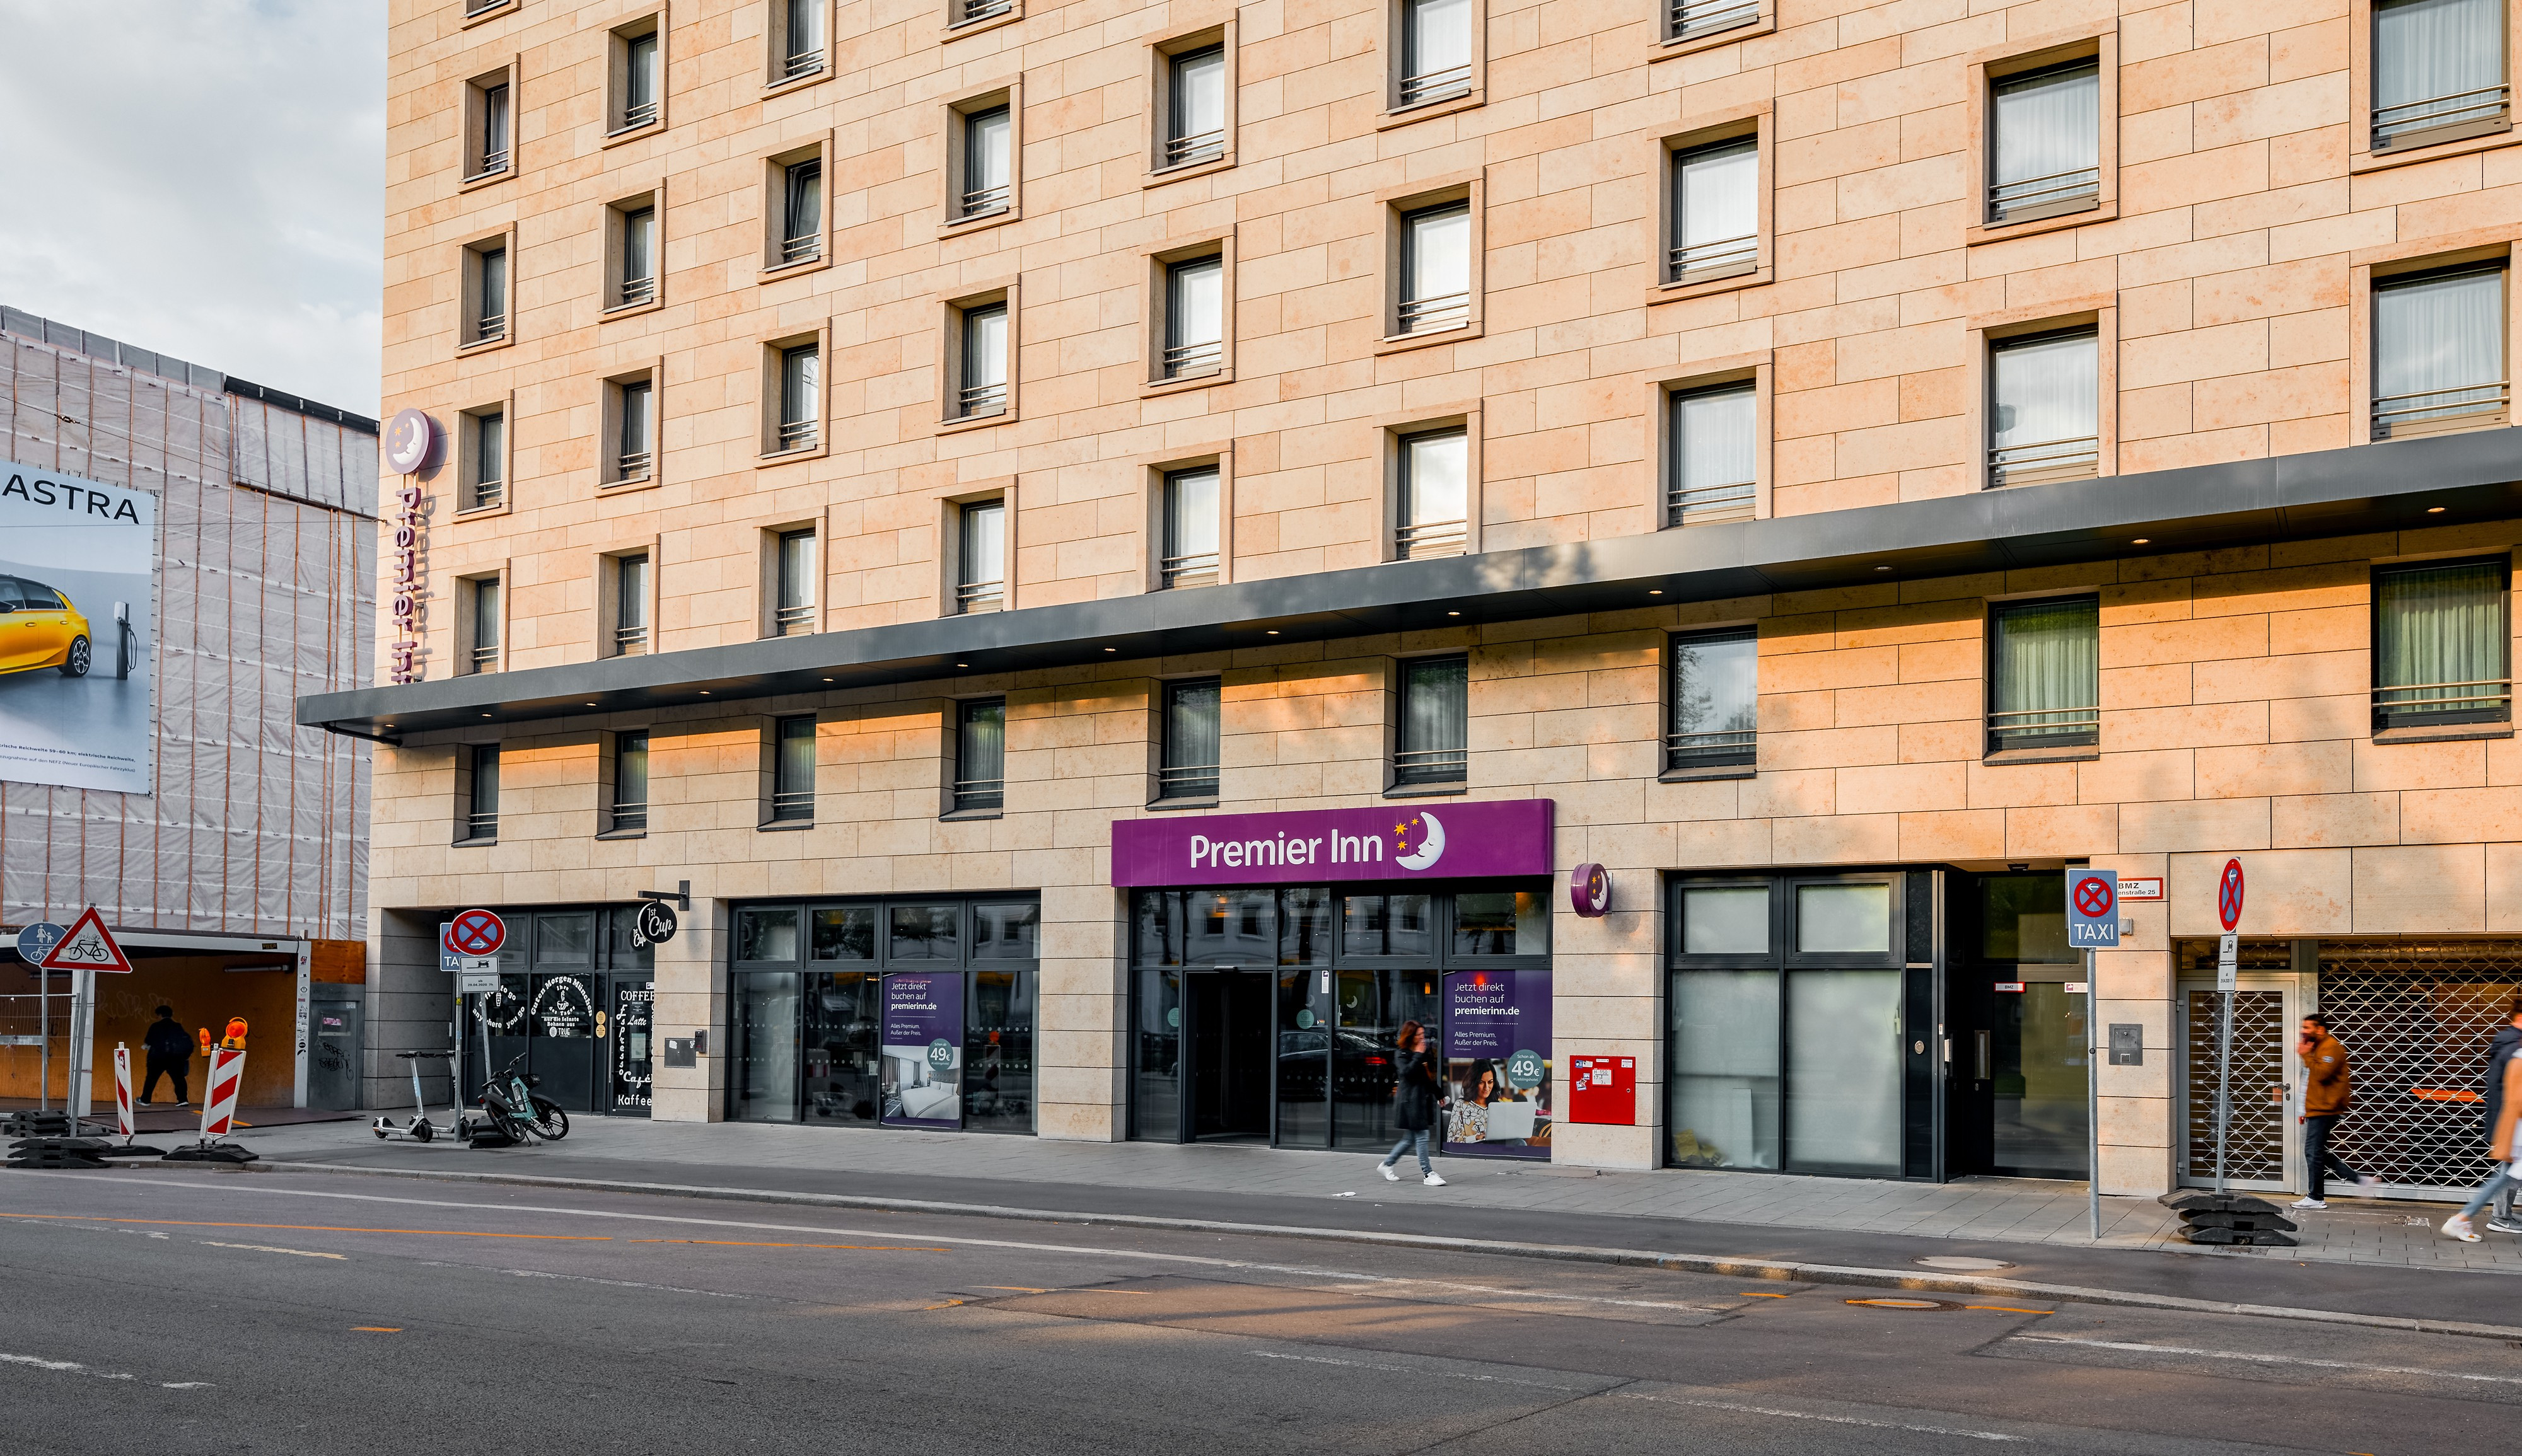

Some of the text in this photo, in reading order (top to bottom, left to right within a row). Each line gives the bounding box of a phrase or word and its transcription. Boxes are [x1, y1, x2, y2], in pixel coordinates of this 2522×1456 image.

[2, 474, 139, 525] ASTRA
[392, 487, 421, 633] Premier
[1190, 829, 1383, 868] Premier Inn
[647, 908, 656, 921] 1st
[648, 916, 673, 937] Cup
[2074, 923, 2114, 940] TAXI
[444, 956, 460, 967] TA
[891, 982, 907, 990] Jetzt
[1455, 983, 1504, 991] Jetzt direkt
[500, 985, 508, 993] to
[508, 991, 516, 1001] go
[531, 976, 593, 1017] Guten Morgen München
[620, 990, 654, 1001] COFFEE
[1455, 994, 1505, 1003] buchen auf
[560, 1005, 576, 1016] Tages
[891, 1002, 937, 1011] premierinn.de
[1455, 1006, 1520, 1017] premierinn.de
[472, 1006, 525, 1029] anyhere you go
[627, 1014, 647, 1026] Latte
[558, 1027, 571, 1036] TRUE
[616, 1004, 628, 1075] Espresso
[623, 1071, 652, 1089] Café
[618, 1094, 652, 1106] Kaffee
